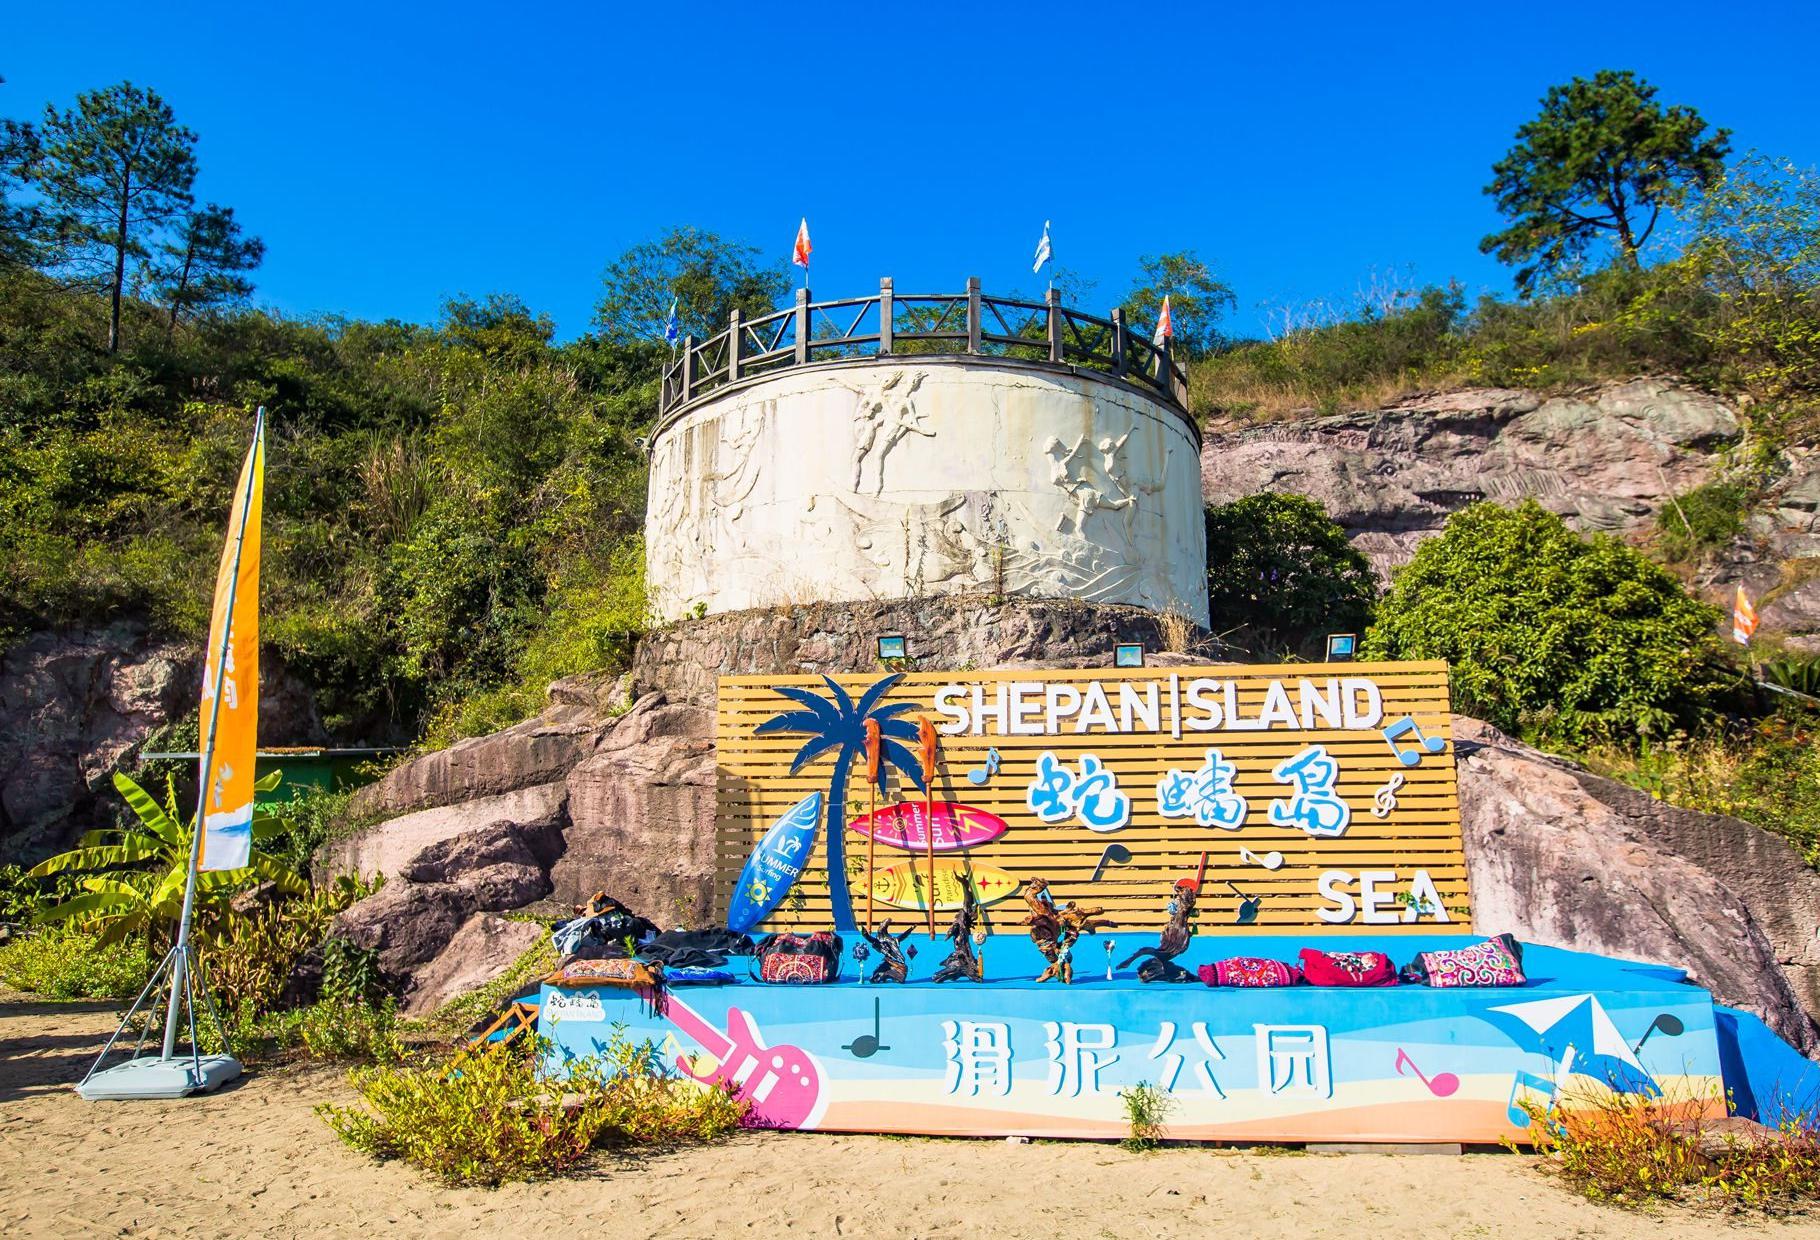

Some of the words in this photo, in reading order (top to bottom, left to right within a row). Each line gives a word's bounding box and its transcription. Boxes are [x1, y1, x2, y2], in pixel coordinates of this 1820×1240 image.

[934, 682, 1160, 736] SHEPAN
[911, 803, 926, 845] Summer
[757, 851, 799, 878] UMMER
[1315, 870, 1450, 924] SEA
[940, 1020, 1333, 1099] 滑泥公园
